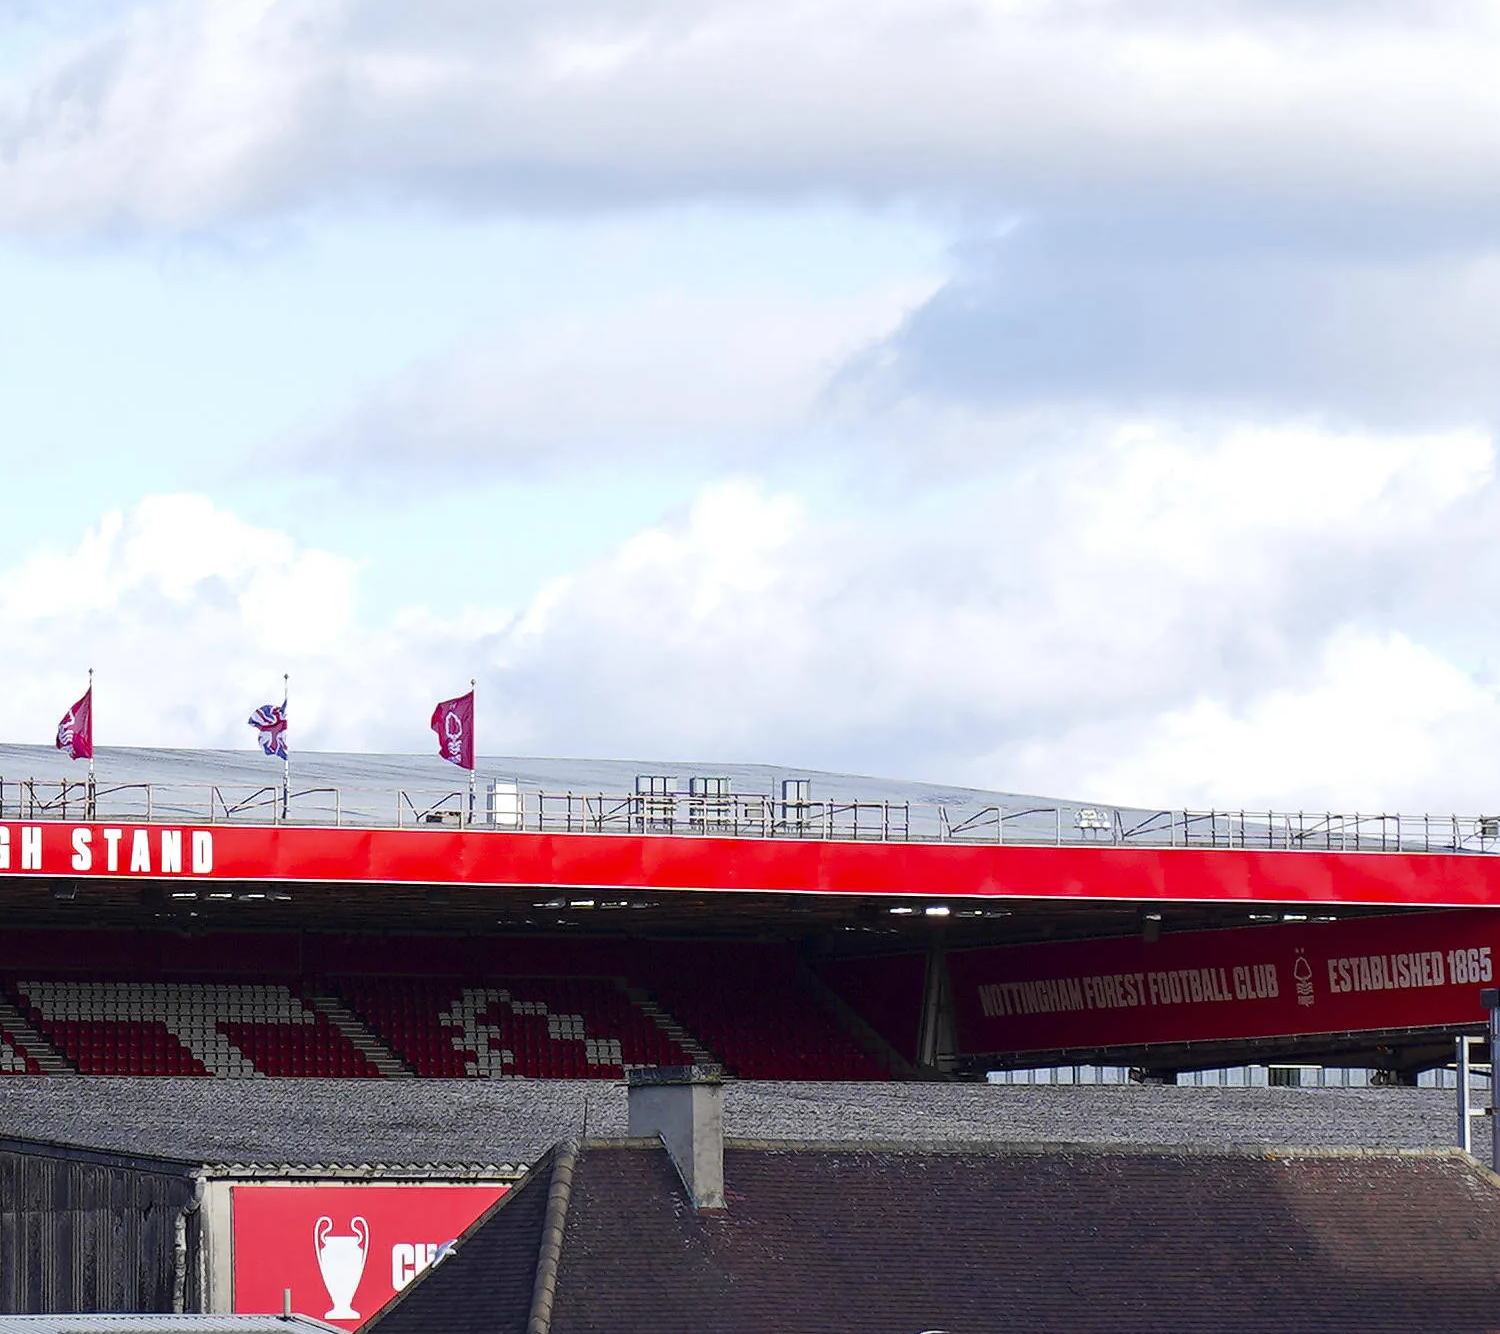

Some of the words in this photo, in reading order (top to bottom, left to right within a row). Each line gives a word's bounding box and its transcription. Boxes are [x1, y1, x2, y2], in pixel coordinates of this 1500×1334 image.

[71, 827, 213, 874] STAND
[977, 977, 1085, 1017] NOTTINGHAM
[1083, 972, 1147, 1010] FOREST
[1147, 966, 1232, 1006] FOOTBALL
[1232, 963, 1280, 1001] CLUB
[1327, 950, 1445, 994] ESTABLISHED
[1447, 946, 1493, 985] 1865
